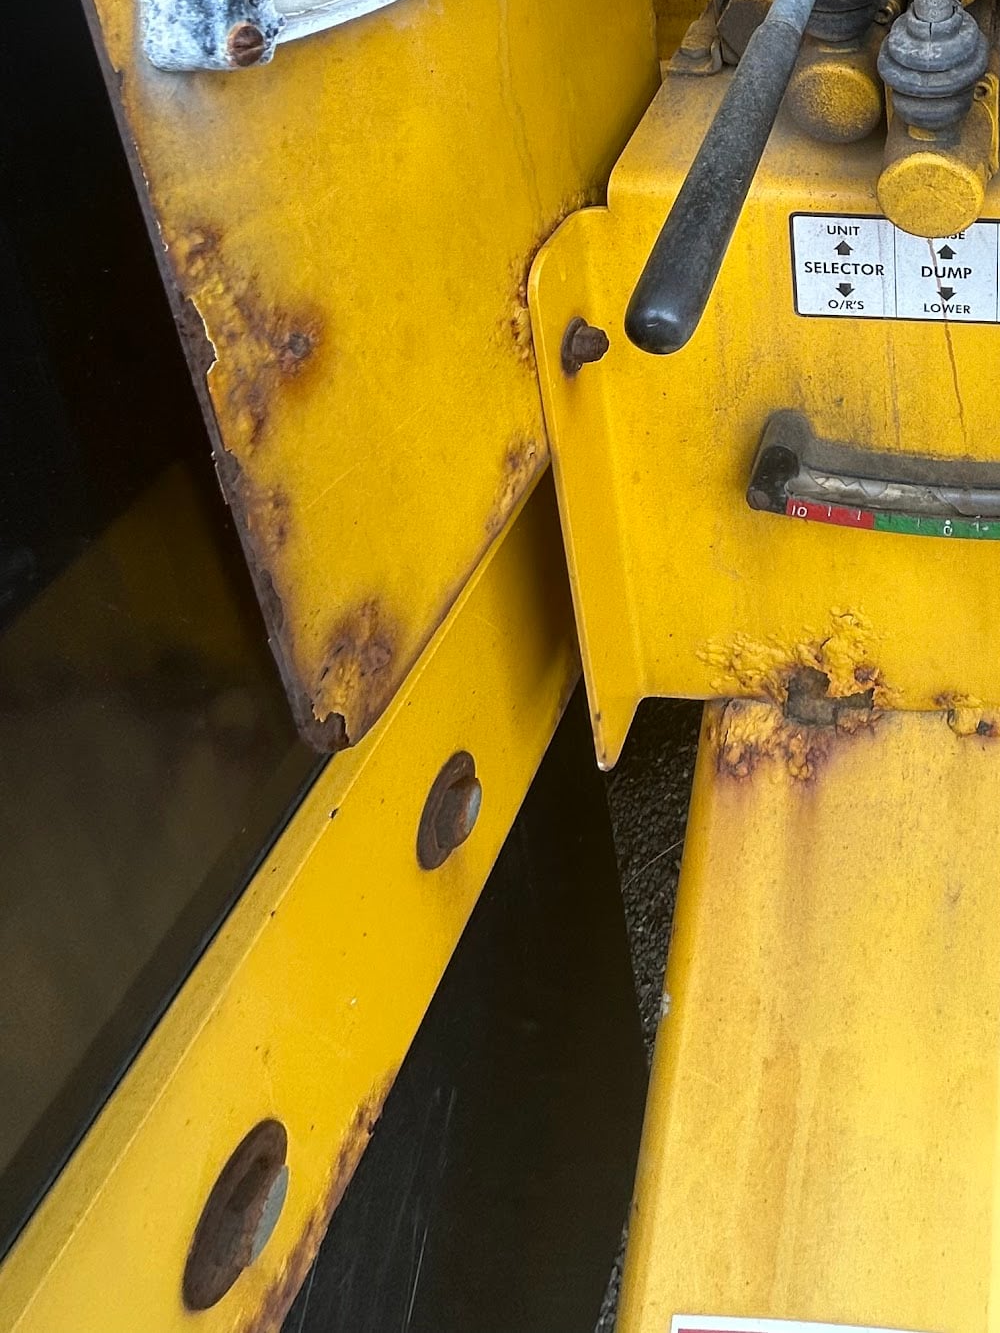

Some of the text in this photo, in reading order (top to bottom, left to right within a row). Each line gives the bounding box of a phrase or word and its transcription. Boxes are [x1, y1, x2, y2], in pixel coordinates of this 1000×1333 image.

[826, 225, 860, 236] UNIT
[804, 261, 884, 277] SELECTOR
[921, 266, 972, 279] DUMP
[828, 299, 864, 311] O/R'S
[923, 303, 970, 315] LOWER
[791, 504, 808, 518] 10
[943, 525, 953, 536] 0
